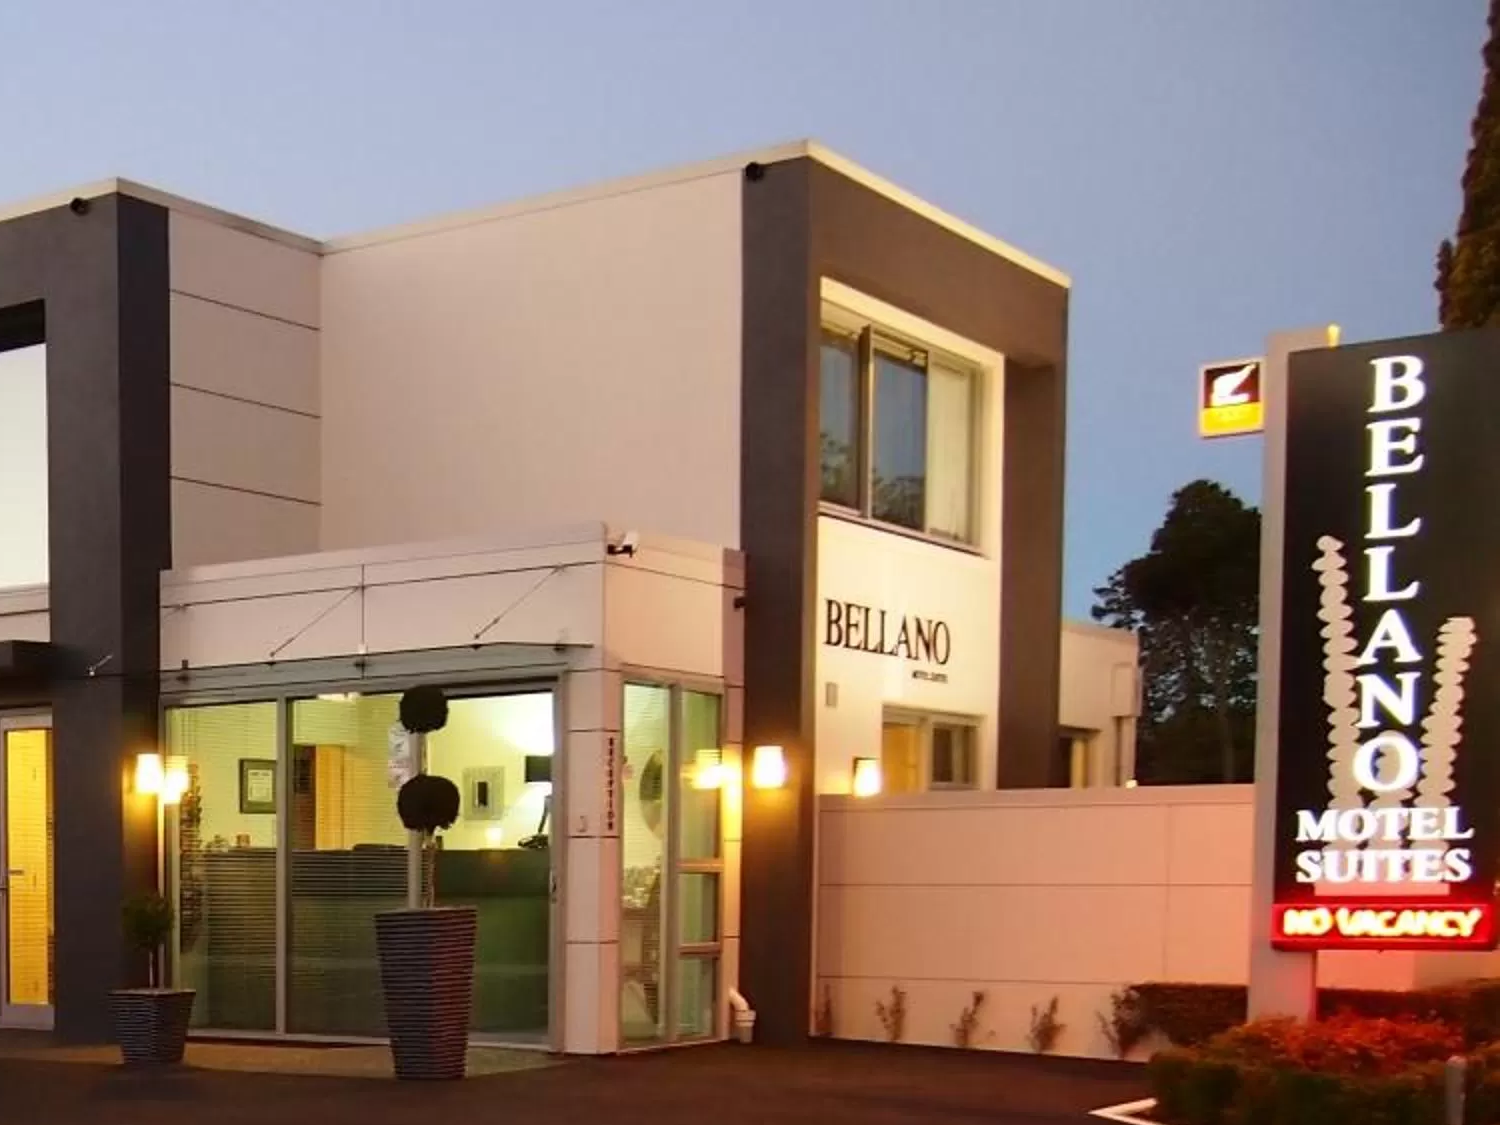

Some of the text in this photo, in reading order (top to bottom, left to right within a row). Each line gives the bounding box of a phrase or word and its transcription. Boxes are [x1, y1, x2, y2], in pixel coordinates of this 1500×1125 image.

[1353, 355, 1426, 791] BELLANO
[823, 598, 951, 665] BELLANO
[1295, 806, 1475, 842] MOTEL
[1296, 848, 1473, 883] SUITES
[1283, 907, 1482, 937] NO VACANCY
